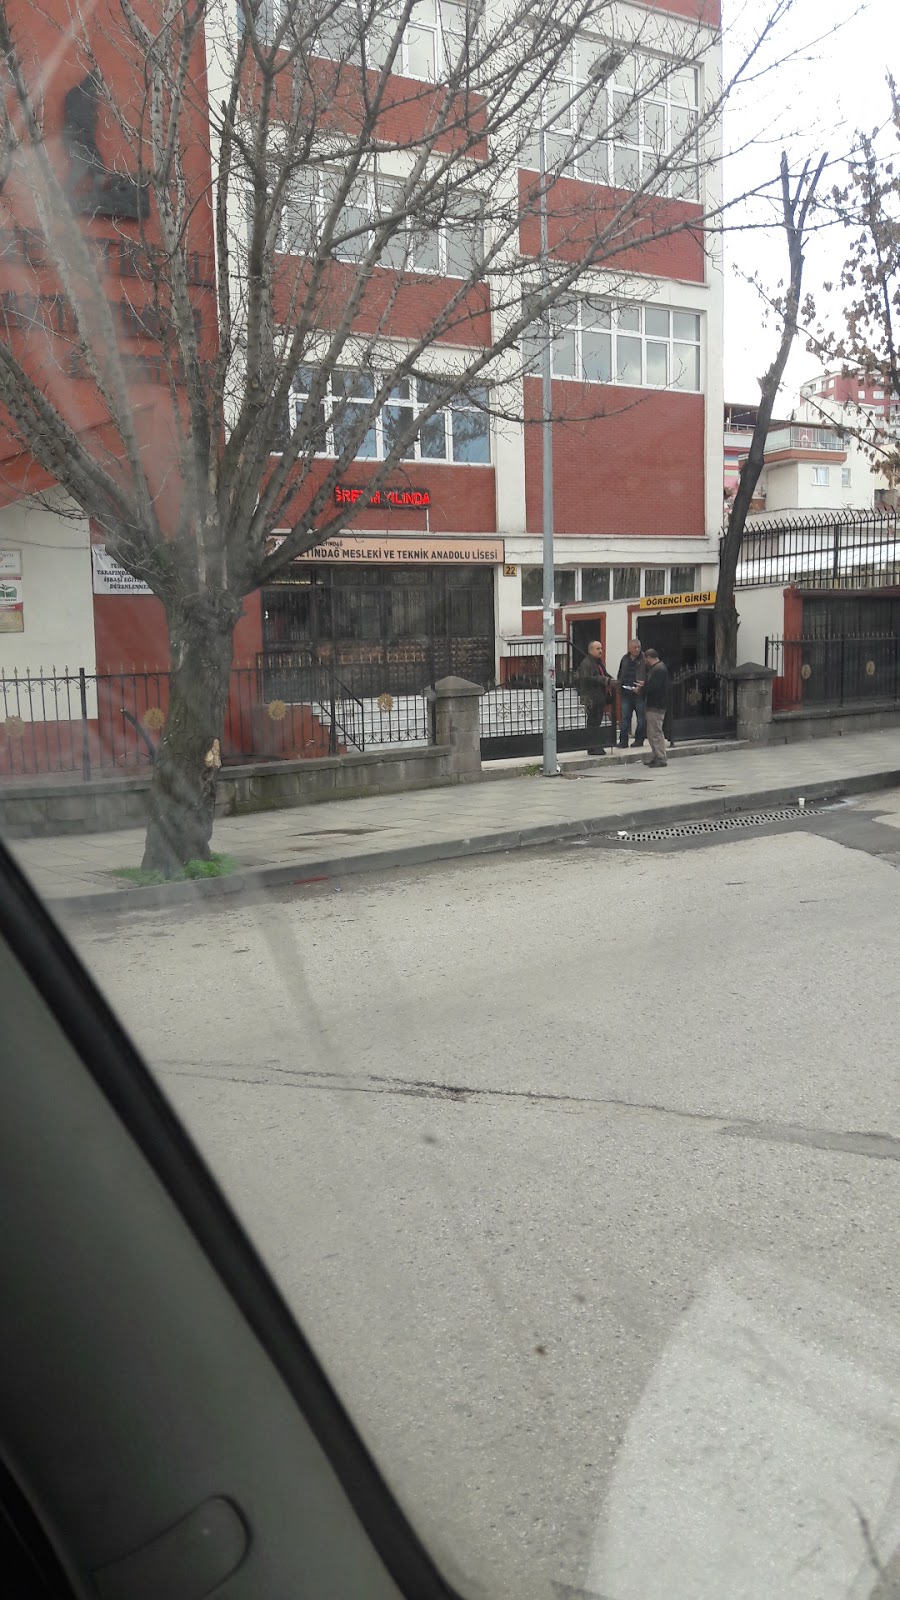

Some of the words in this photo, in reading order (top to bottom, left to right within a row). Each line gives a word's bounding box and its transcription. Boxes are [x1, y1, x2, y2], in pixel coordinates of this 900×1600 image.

[299, 547, 340, 559] TINDAĞ
[342, 547, 382, 559] MESLEKİ
[384, 549, 395, 559] VE
[397, 548, 429, 560] TEKNİK
[431, 550, 471, 560] ANADOLU
[473, 548, 498, 560] LİSESİ
[505, 566, 516, 575] 22
[646, 596, 682, 606] ÖĞRENCİ
[684, 592, 711, 603] GİRİŞİ
